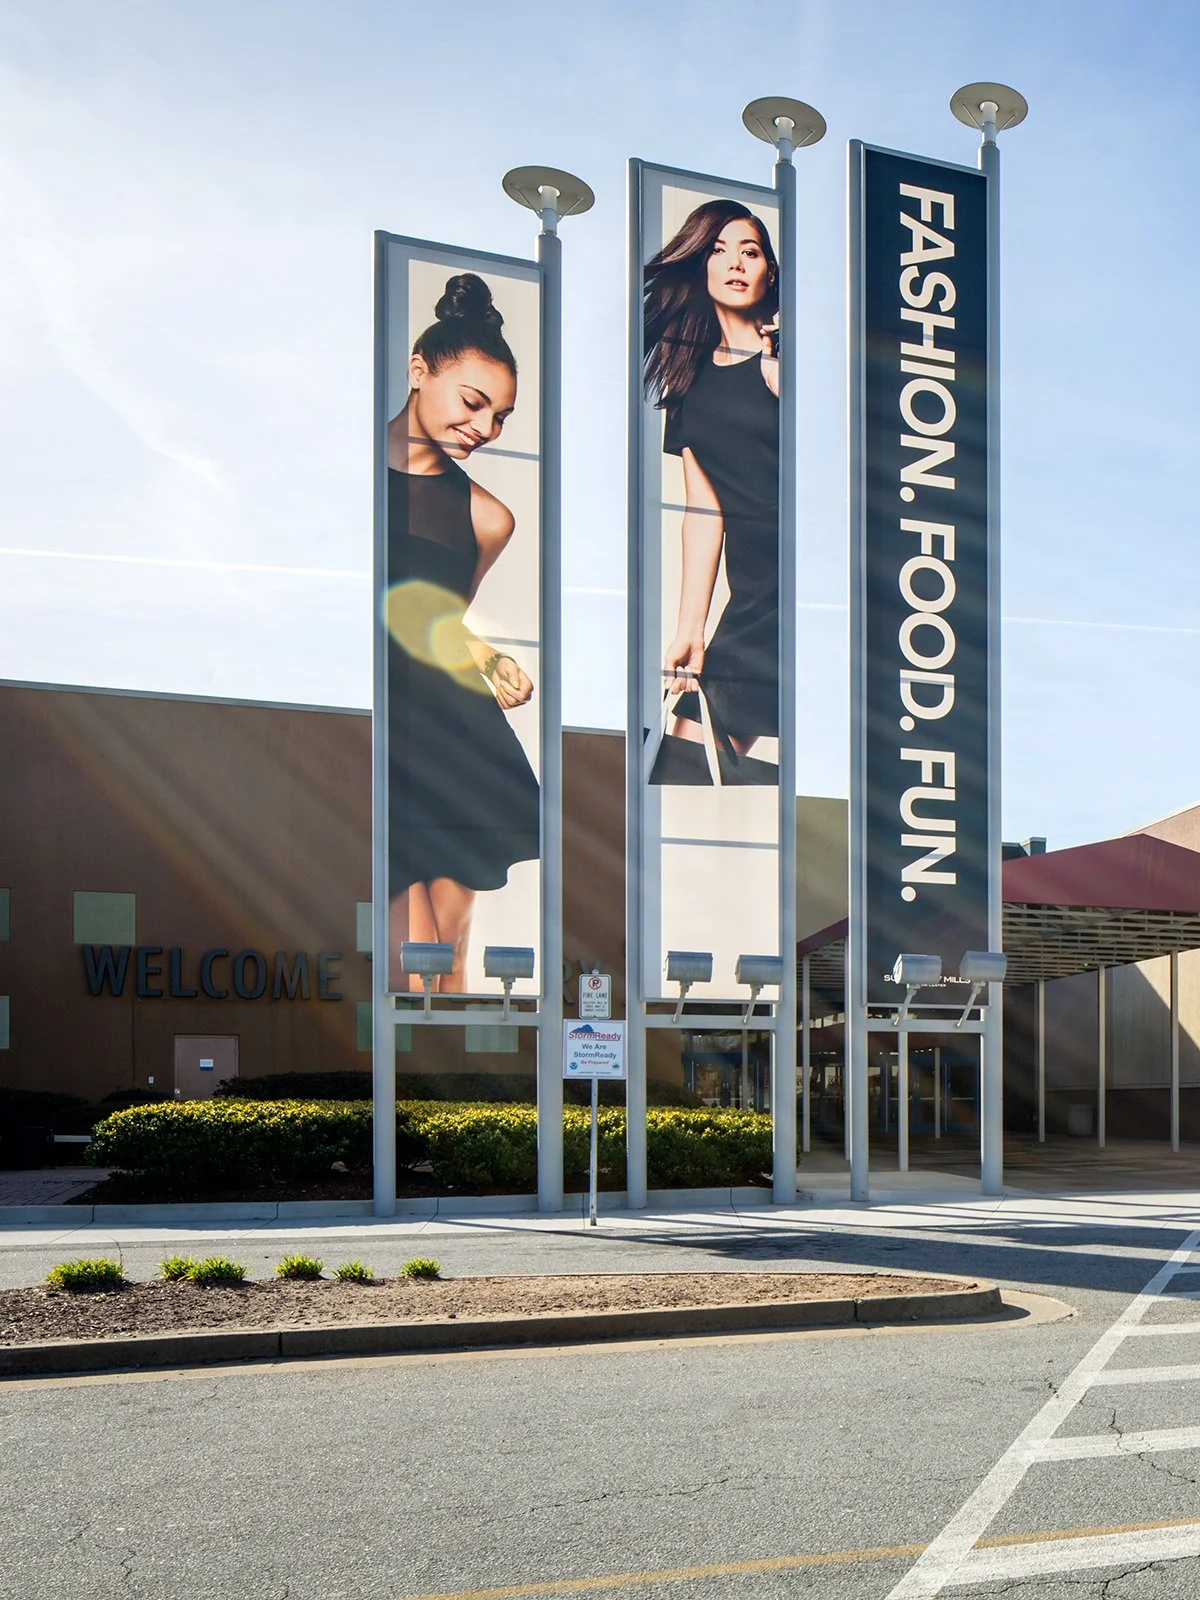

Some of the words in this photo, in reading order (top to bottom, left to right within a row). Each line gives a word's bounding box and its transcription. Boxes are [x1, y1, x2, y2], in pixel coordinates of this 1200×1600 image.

[899, 183, 957, 502] FASHION.
[898, 518, 957, 732] FOOD.
[899, 747, 957, 902] FUN.
[82, 945, 343, 1001] WELCOME
[943, 976, 971, 984] MILLS
[568, 1031, 622, 1041] StormReady
[573, 1051, 617, 1060] StormReady
